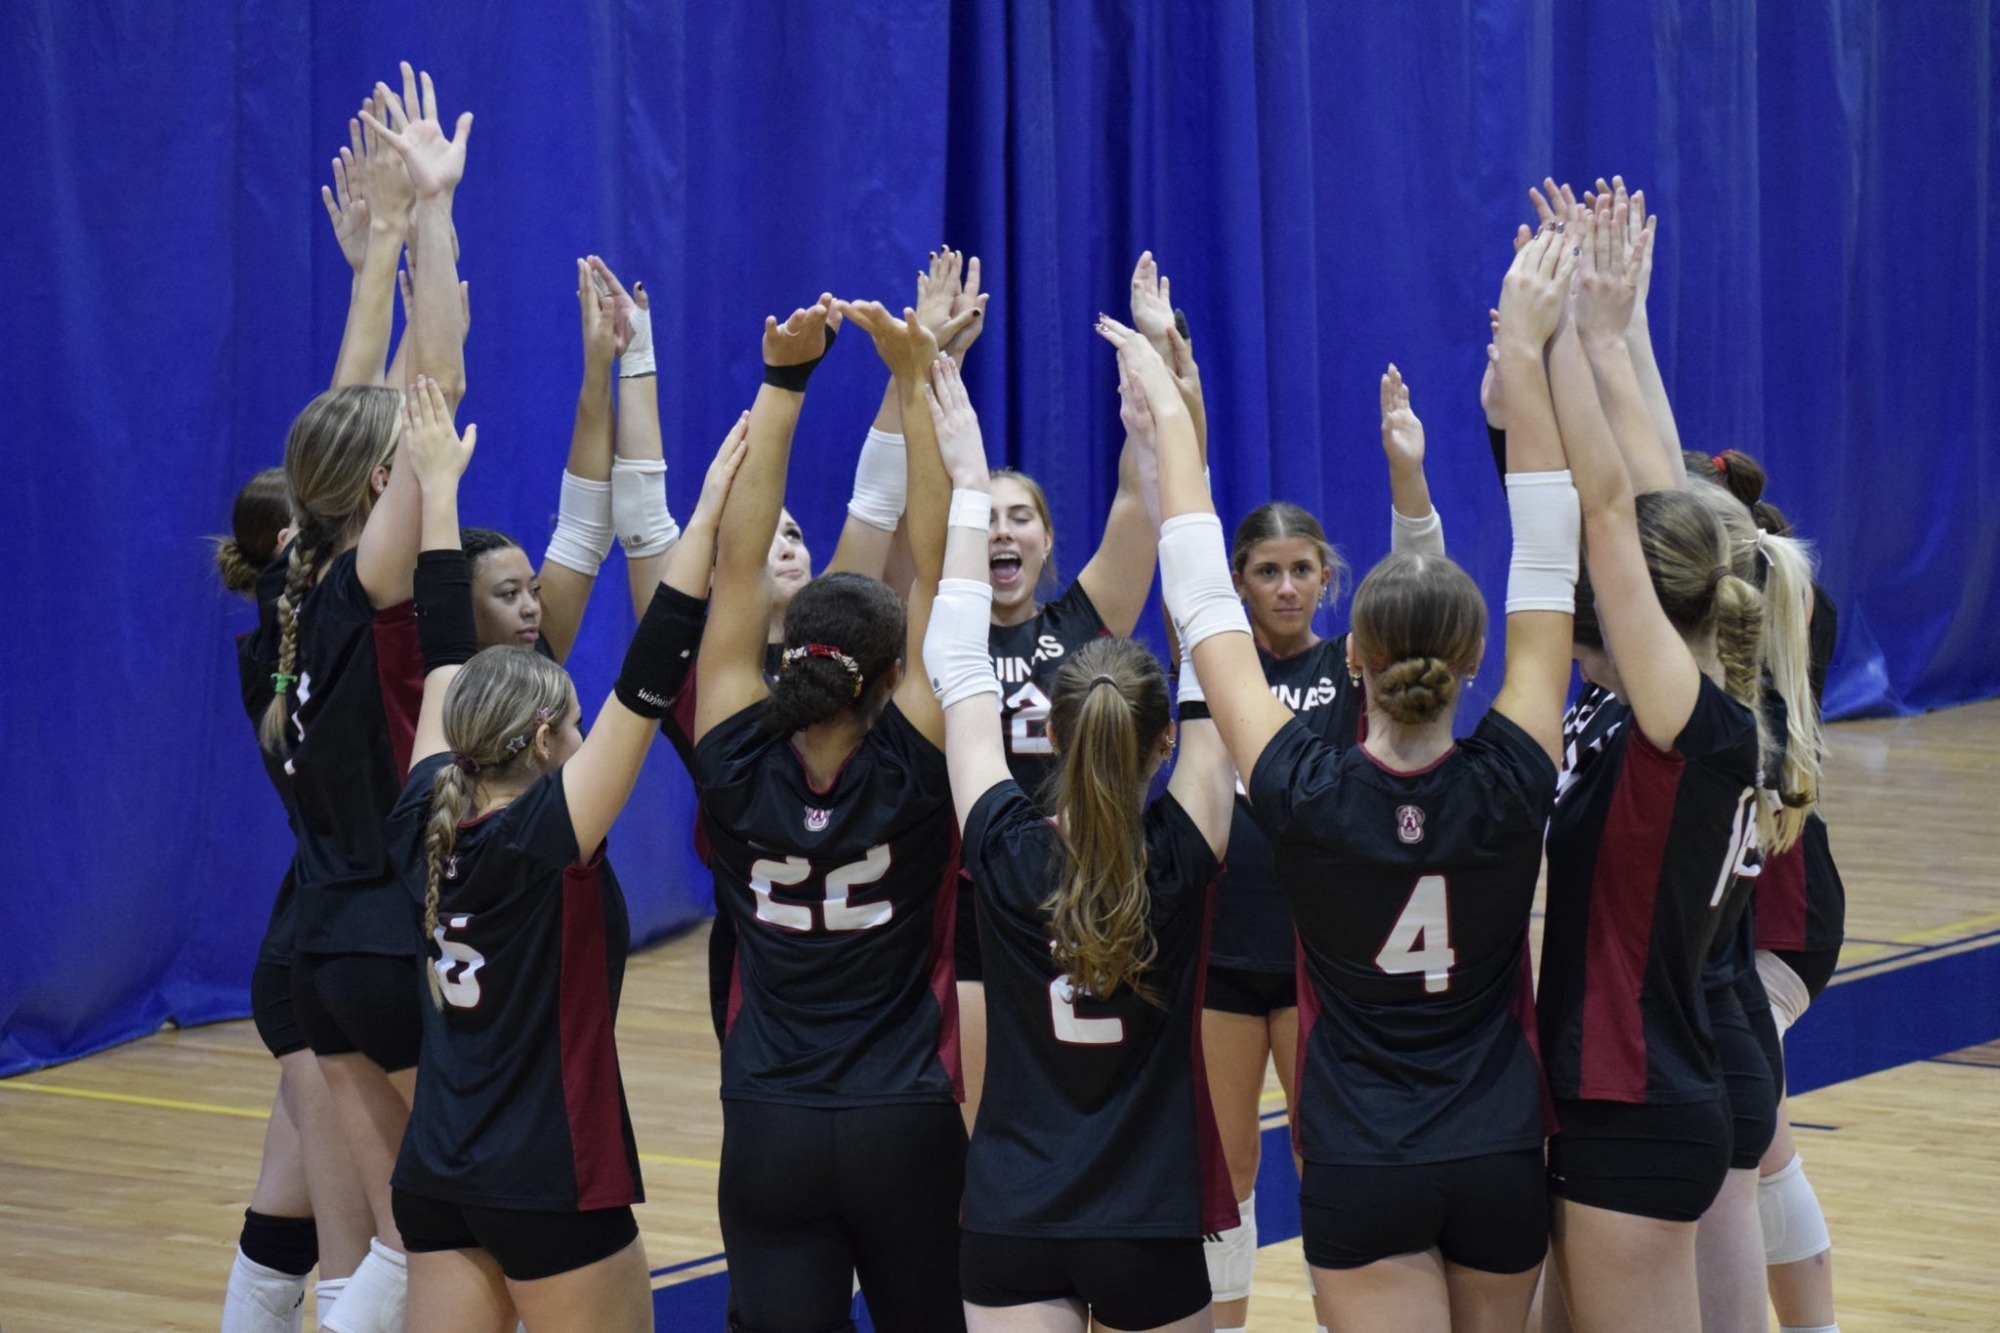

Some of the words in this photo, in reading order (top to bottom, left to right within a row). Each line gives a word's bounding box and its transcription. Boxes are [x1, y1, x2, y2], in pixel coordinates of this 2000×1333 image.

[1003, 681, 1054, 753] 2
[749, 843, 895, 932] 22
[1376, 875, 1455, 993] 4
